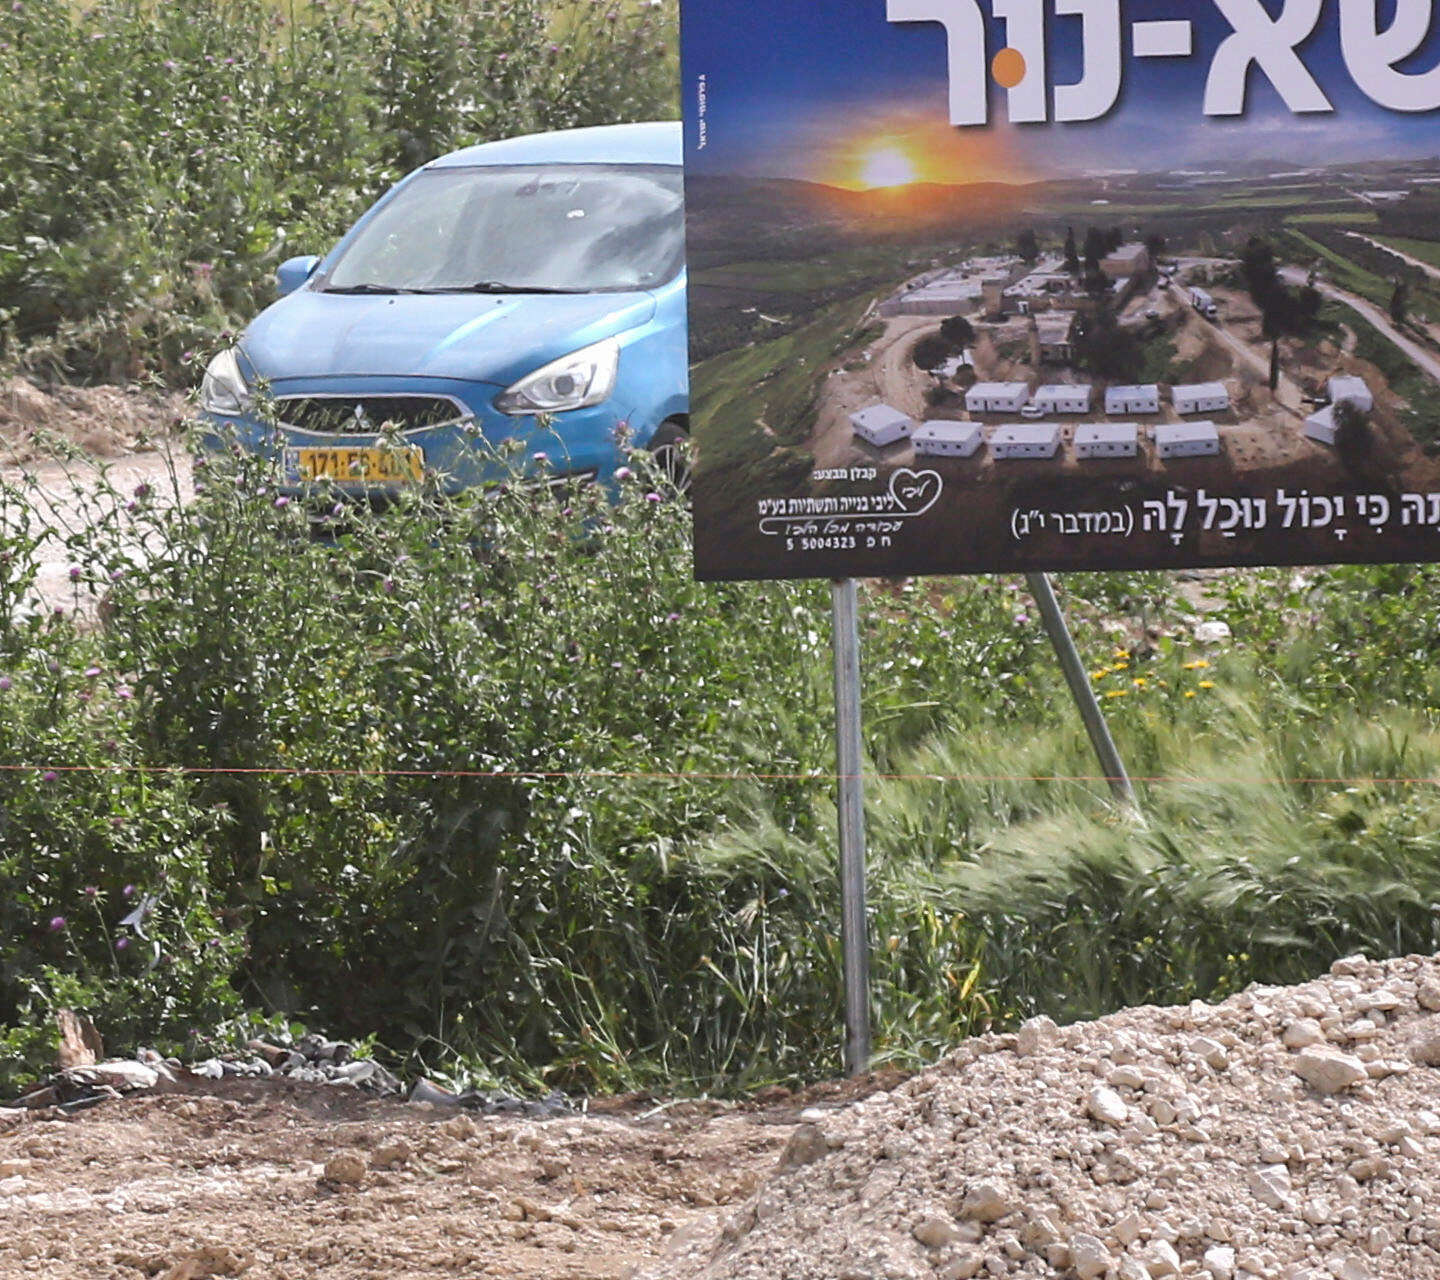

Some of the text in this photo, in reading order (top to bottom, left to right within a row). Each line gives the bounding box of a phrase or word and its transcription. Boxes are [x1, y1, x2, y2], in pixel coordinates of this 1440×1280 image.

[850, 467, 877, 482] קבלן
[788, 497, 838, 514] ותשתיות
[840, 497, 869, 513] בנייה
[1050, 504, 1134, 537] (במדבר
